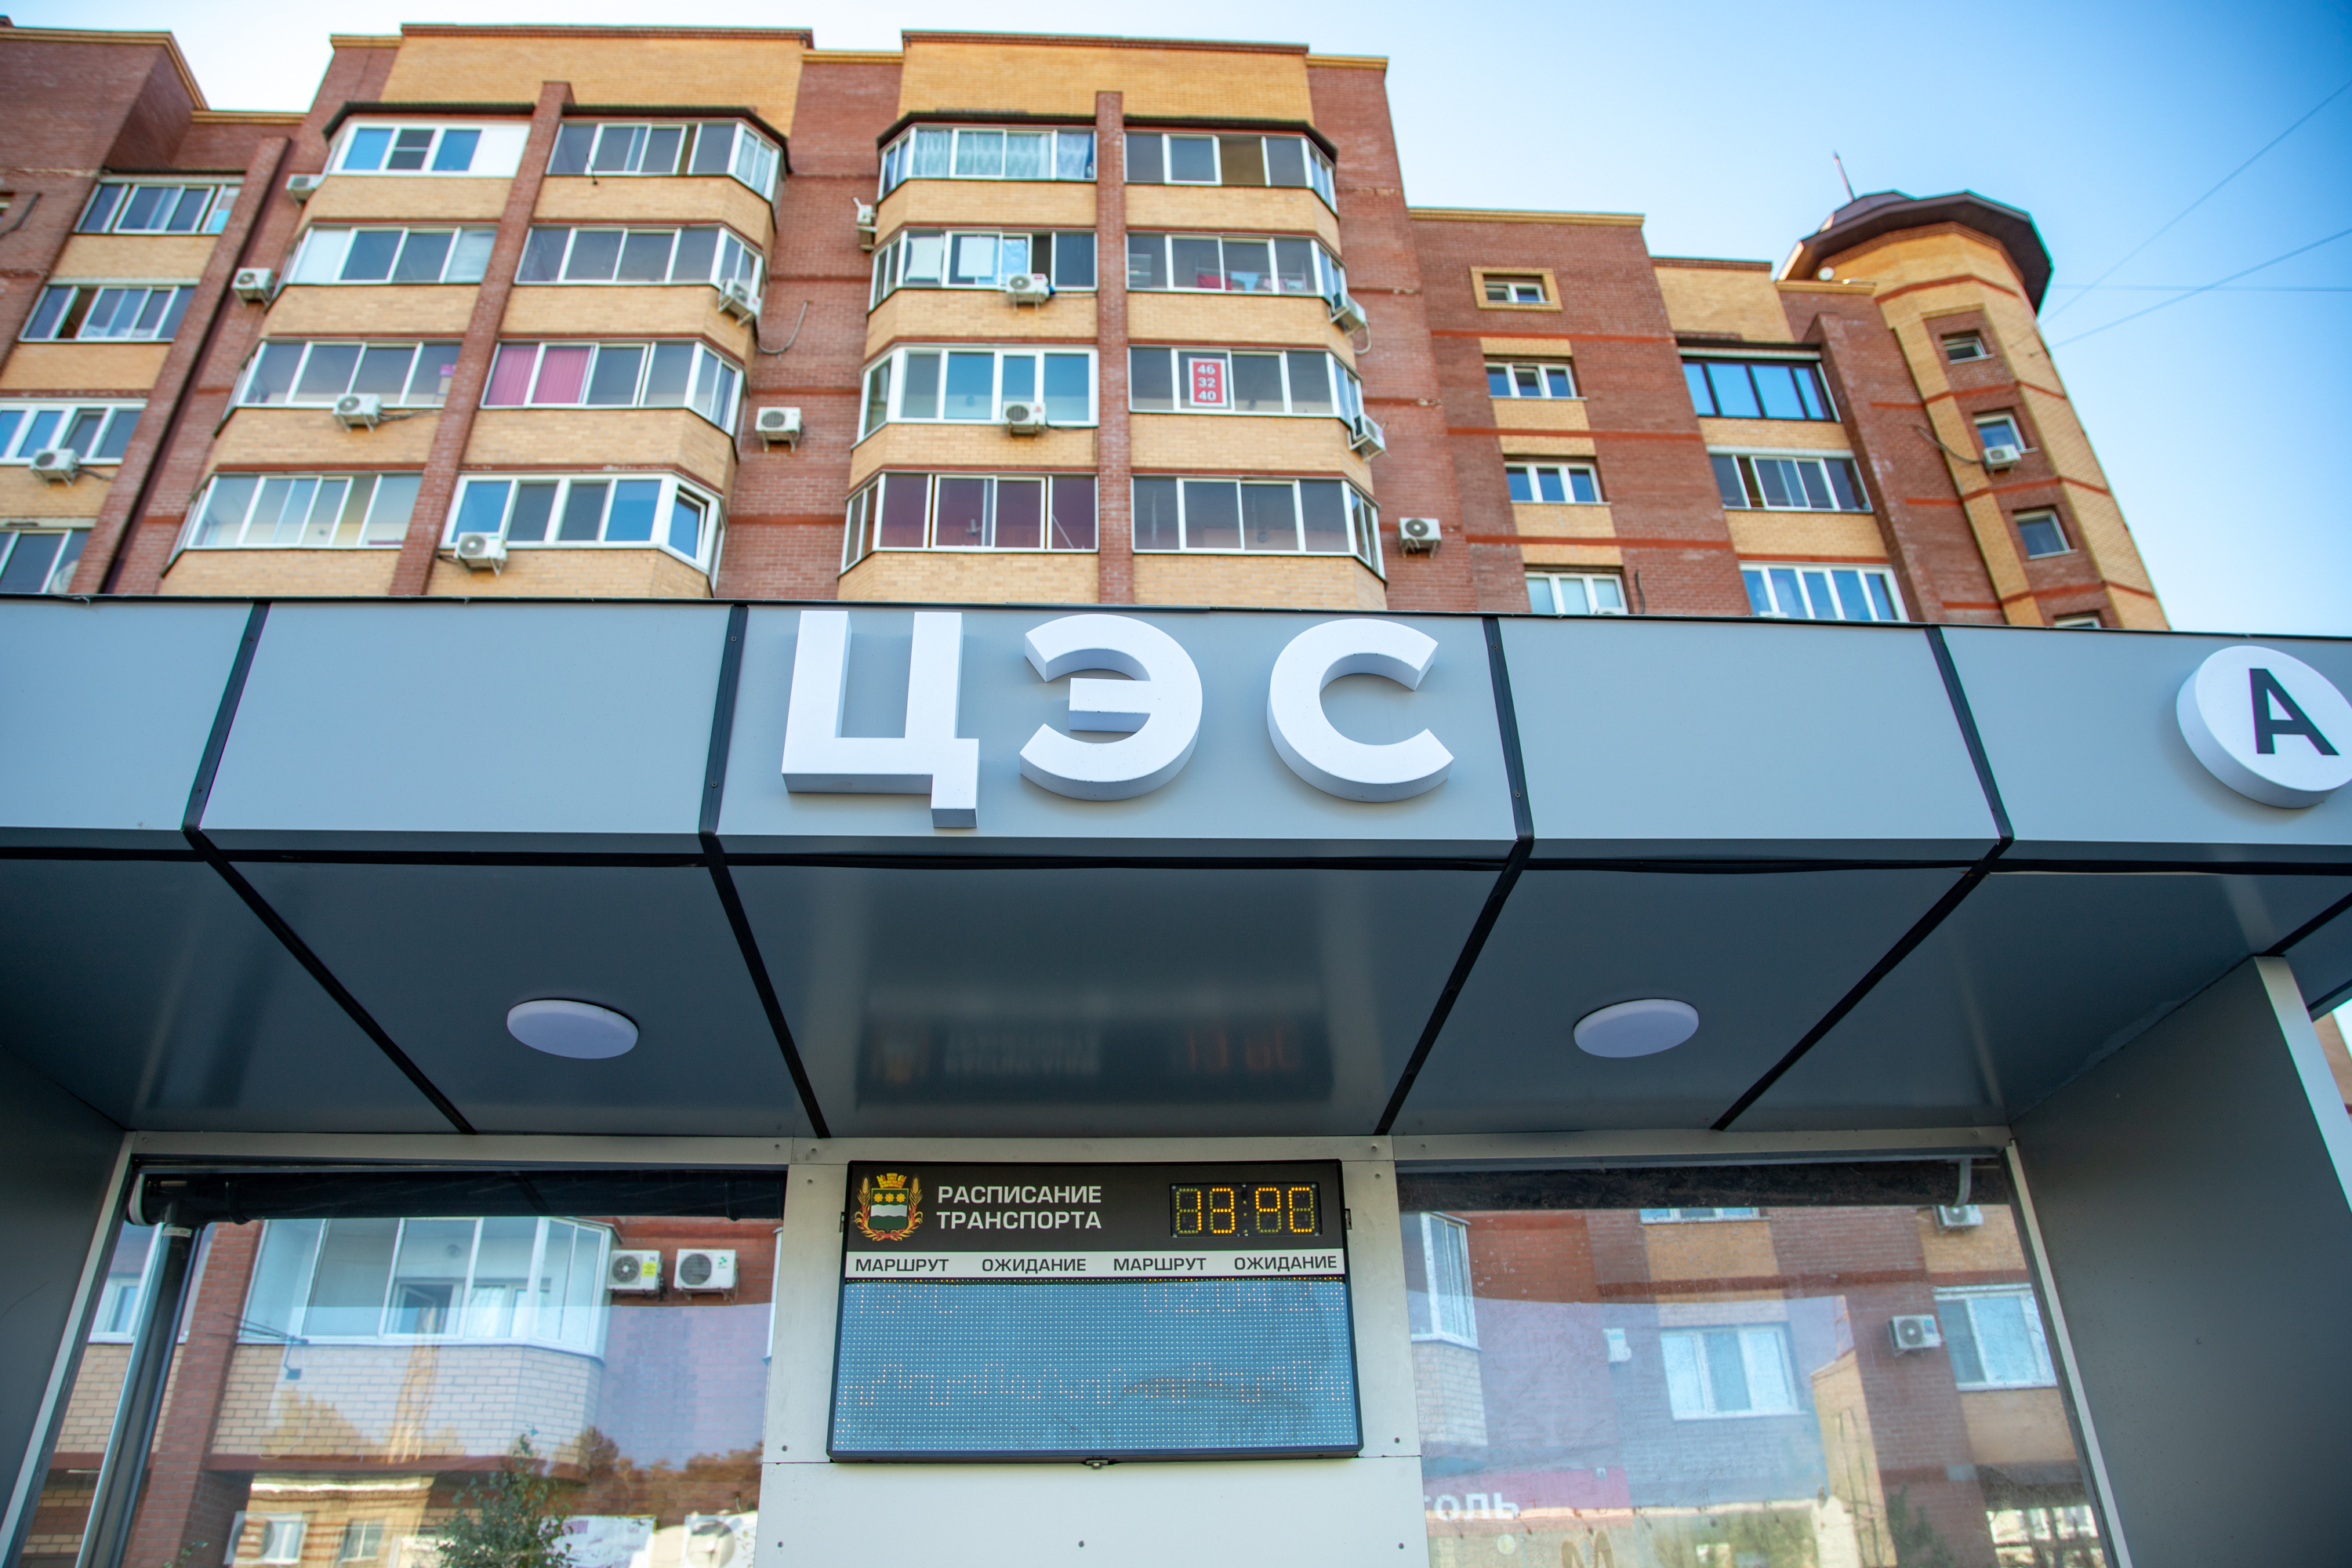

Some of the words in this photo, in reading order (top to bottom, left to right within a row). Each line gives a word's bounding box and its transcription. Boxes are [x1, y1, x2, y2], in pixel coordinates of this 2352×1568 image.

[1196, 364, 1215, 374] 46
[1197, 376, 1216, 387] 32
[1197, 390, 1217, 401] 40
[782, 611, 1454, 828] ЦЭС
[2249, 668, 2340, 756] А
[938, 1185, 1102, 1204] РАСПИСАНИЕ
[936, 1210, 1102, 1229] ТРАНСПОРТА
[855, 1258, 949, 1272] МАРШРУТ
[982, 1258, 1087, 1275] ОЖИДАНИЕ
[1113, 1258, 1206, 1272] МАРШРУТ
[1234, 1255, 1338, 1273] ОЖИДАНИЕ
